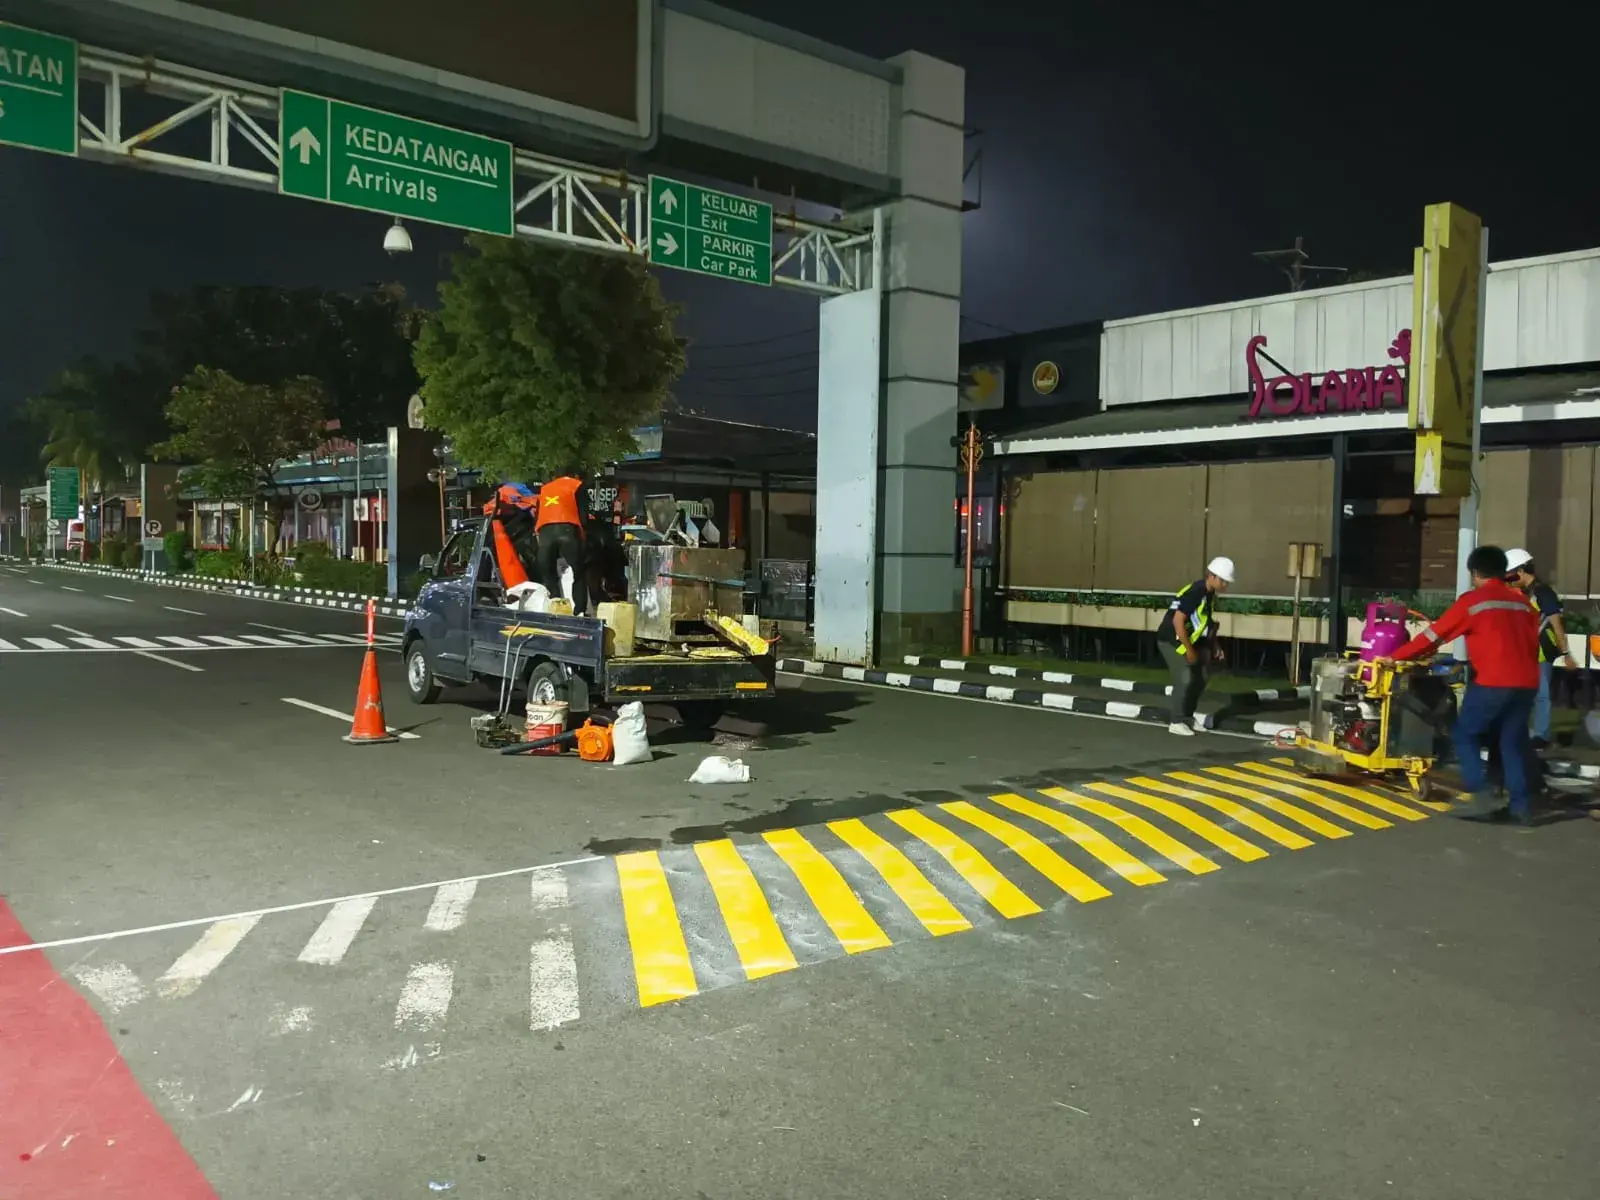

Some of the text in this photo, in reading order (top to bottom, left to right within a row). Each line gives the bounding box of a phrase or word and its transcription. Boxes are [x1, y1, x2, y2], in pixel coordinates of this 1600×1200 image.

[0, 46, 63, 85] ATAN
[345, 124, 498, 179] KEDATANGAN
[346, 164, 437, 202] Arrivals
[701, 192, 758, 218] KELUAR
[701, 213, 728, 232] Exit
[702, 234, 755, 258] PARKIR
[700, 256, 757, 279] Car Park
[1246, 335, 1404, 417] SOLARIA
